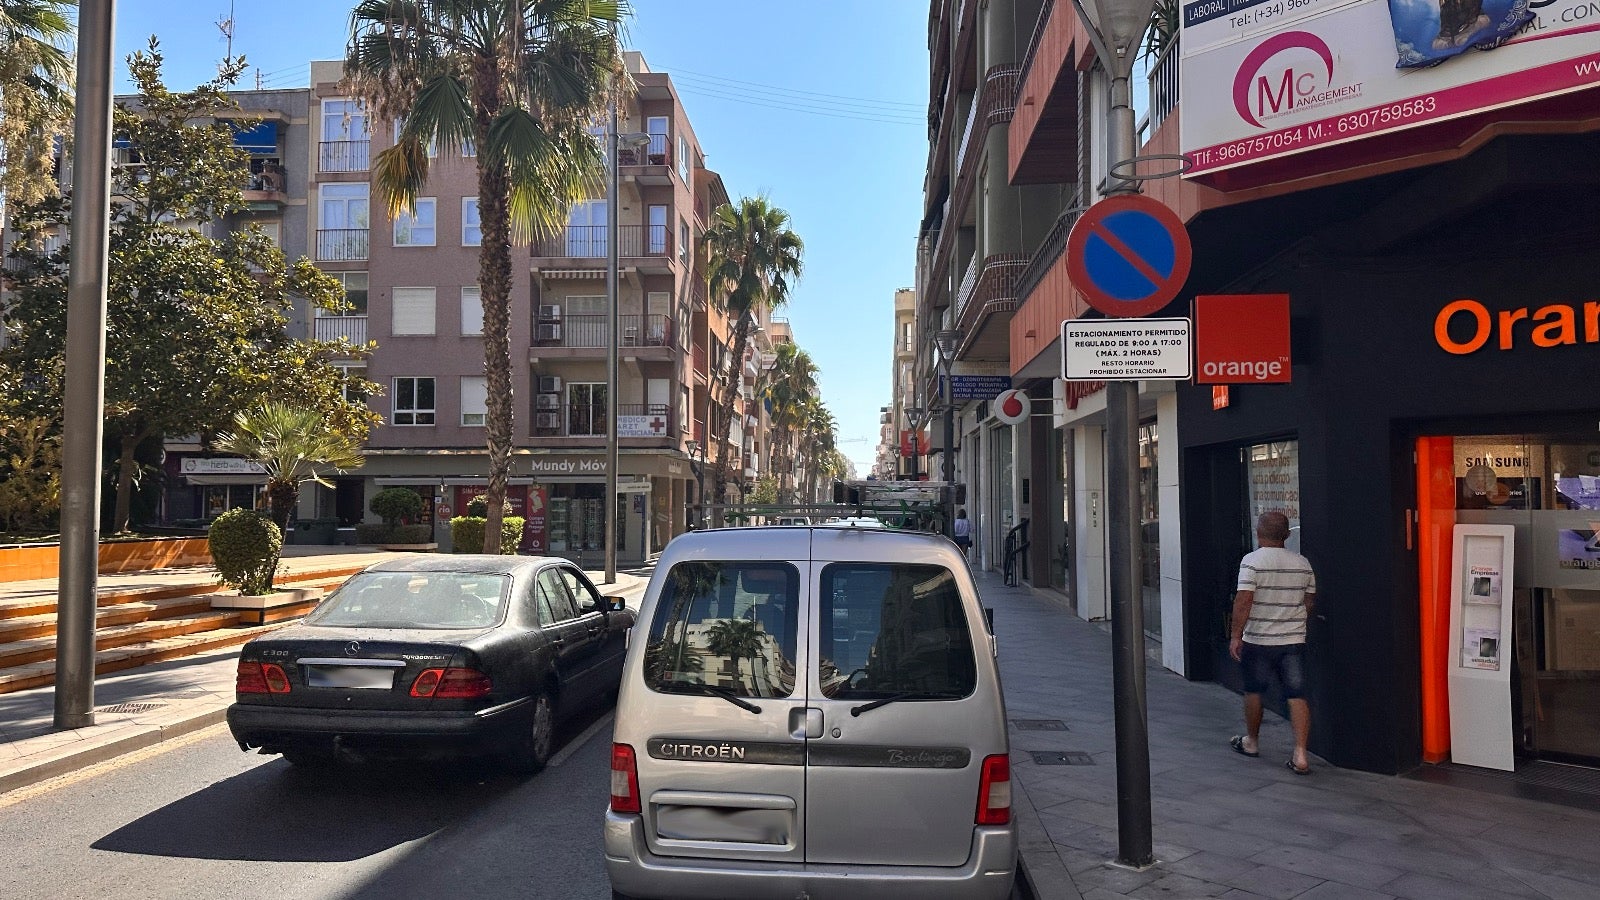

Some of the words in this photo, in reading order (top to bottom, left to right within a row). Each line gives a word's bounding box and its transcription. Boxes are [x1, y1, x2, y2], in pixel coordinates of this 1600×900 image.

[1189, 0, 1226, 20] LABORAL
[1229, 14, 1251, 28] Tel:
[1254, 2, 1284, 23] (+34)
[1307, 124, 1332, 141] M.:
[1337, 97, 1436, 133] 630759583
[1069, 330, 1143, 338] ESTACIONAMIENTO
[1075, 340, 1117, 348] REGULADO
[1130, 349, 1161, 357] HORAS)
[1203, 361, 1282, 380] orange
[532, 459, 575, 473] Mundy
[580, 459, 607, 471] Móv
[1465, 456, 1530, 468] SAMSUNG
[660, 743, 745, 759] CITROËN
